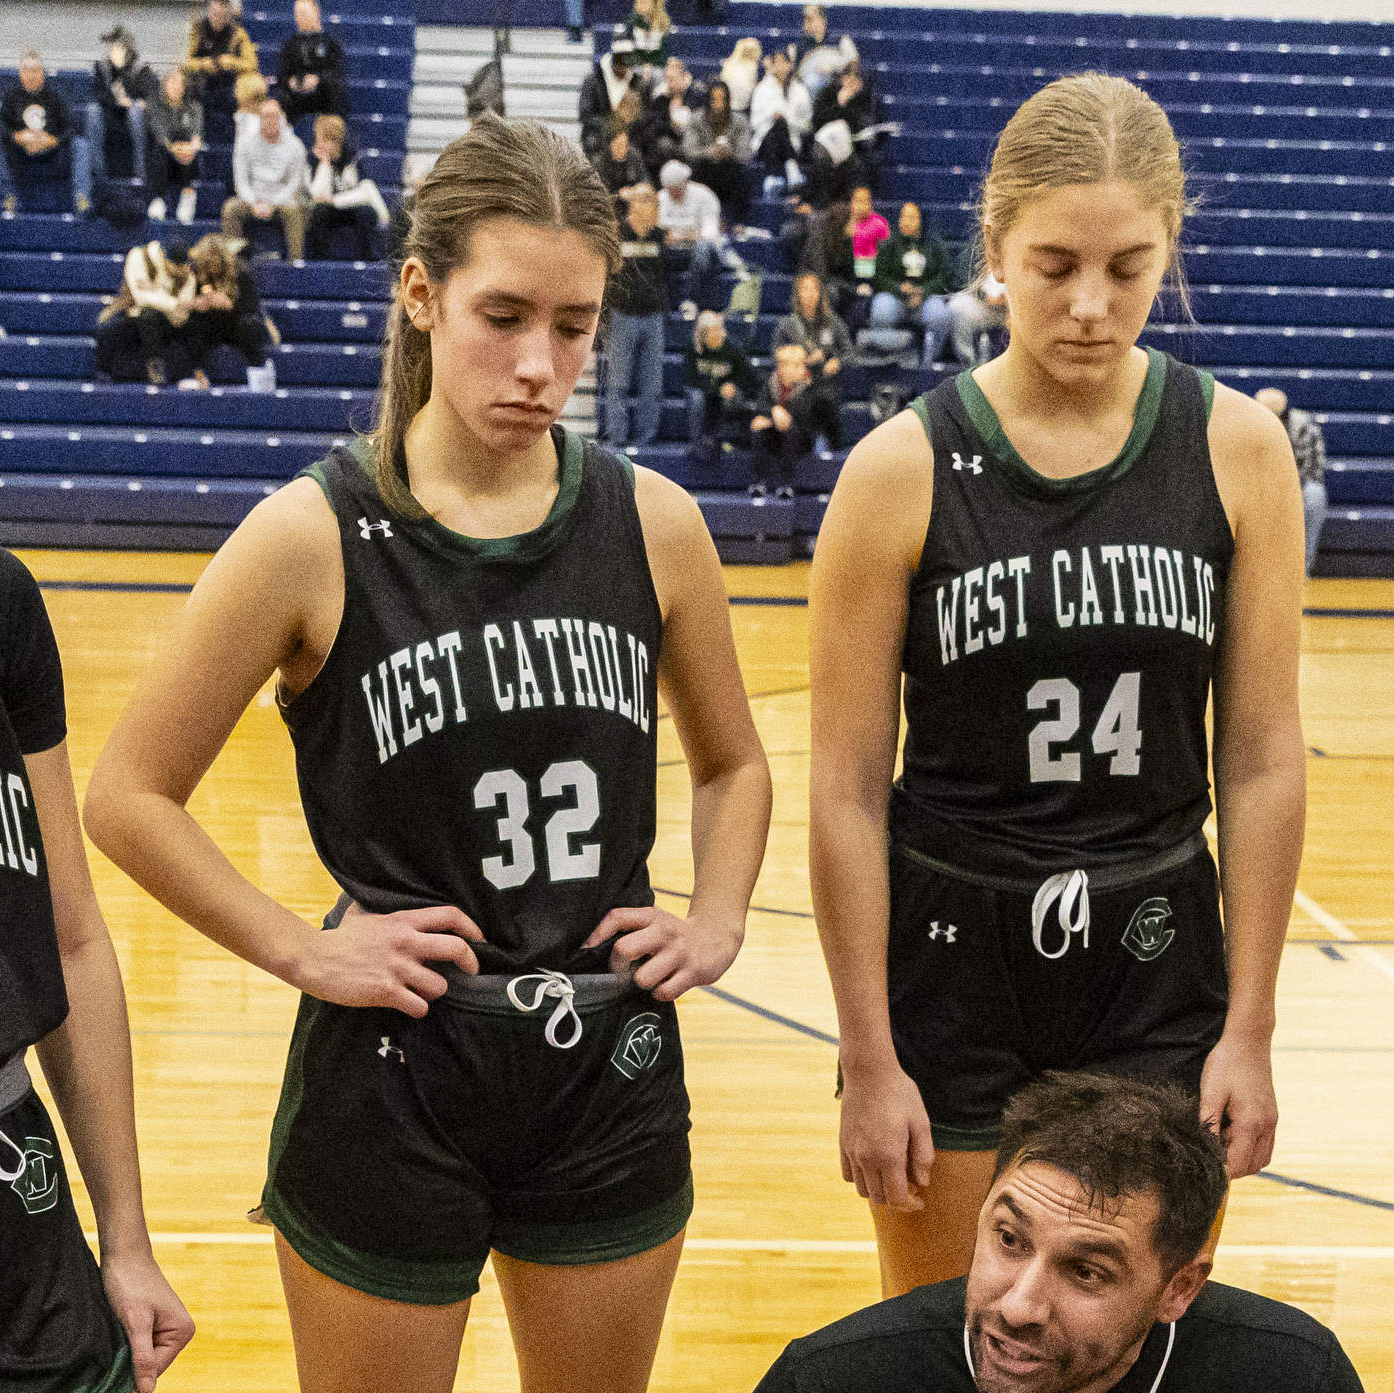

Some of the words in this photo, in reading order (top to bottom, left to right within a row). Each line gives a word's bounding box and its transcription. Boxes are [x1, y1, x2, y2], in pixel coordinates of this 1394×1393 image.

[937, 555, 1031, 666] WEST
[1052, 544, 1215, 646] CATHOLIC
[362, 630, 468, 765] WEST
[483, 618, 650, 734] CATHOLIC
[1026, 671, 1143, 783] 24
[472, 759, 602, 891] 32
